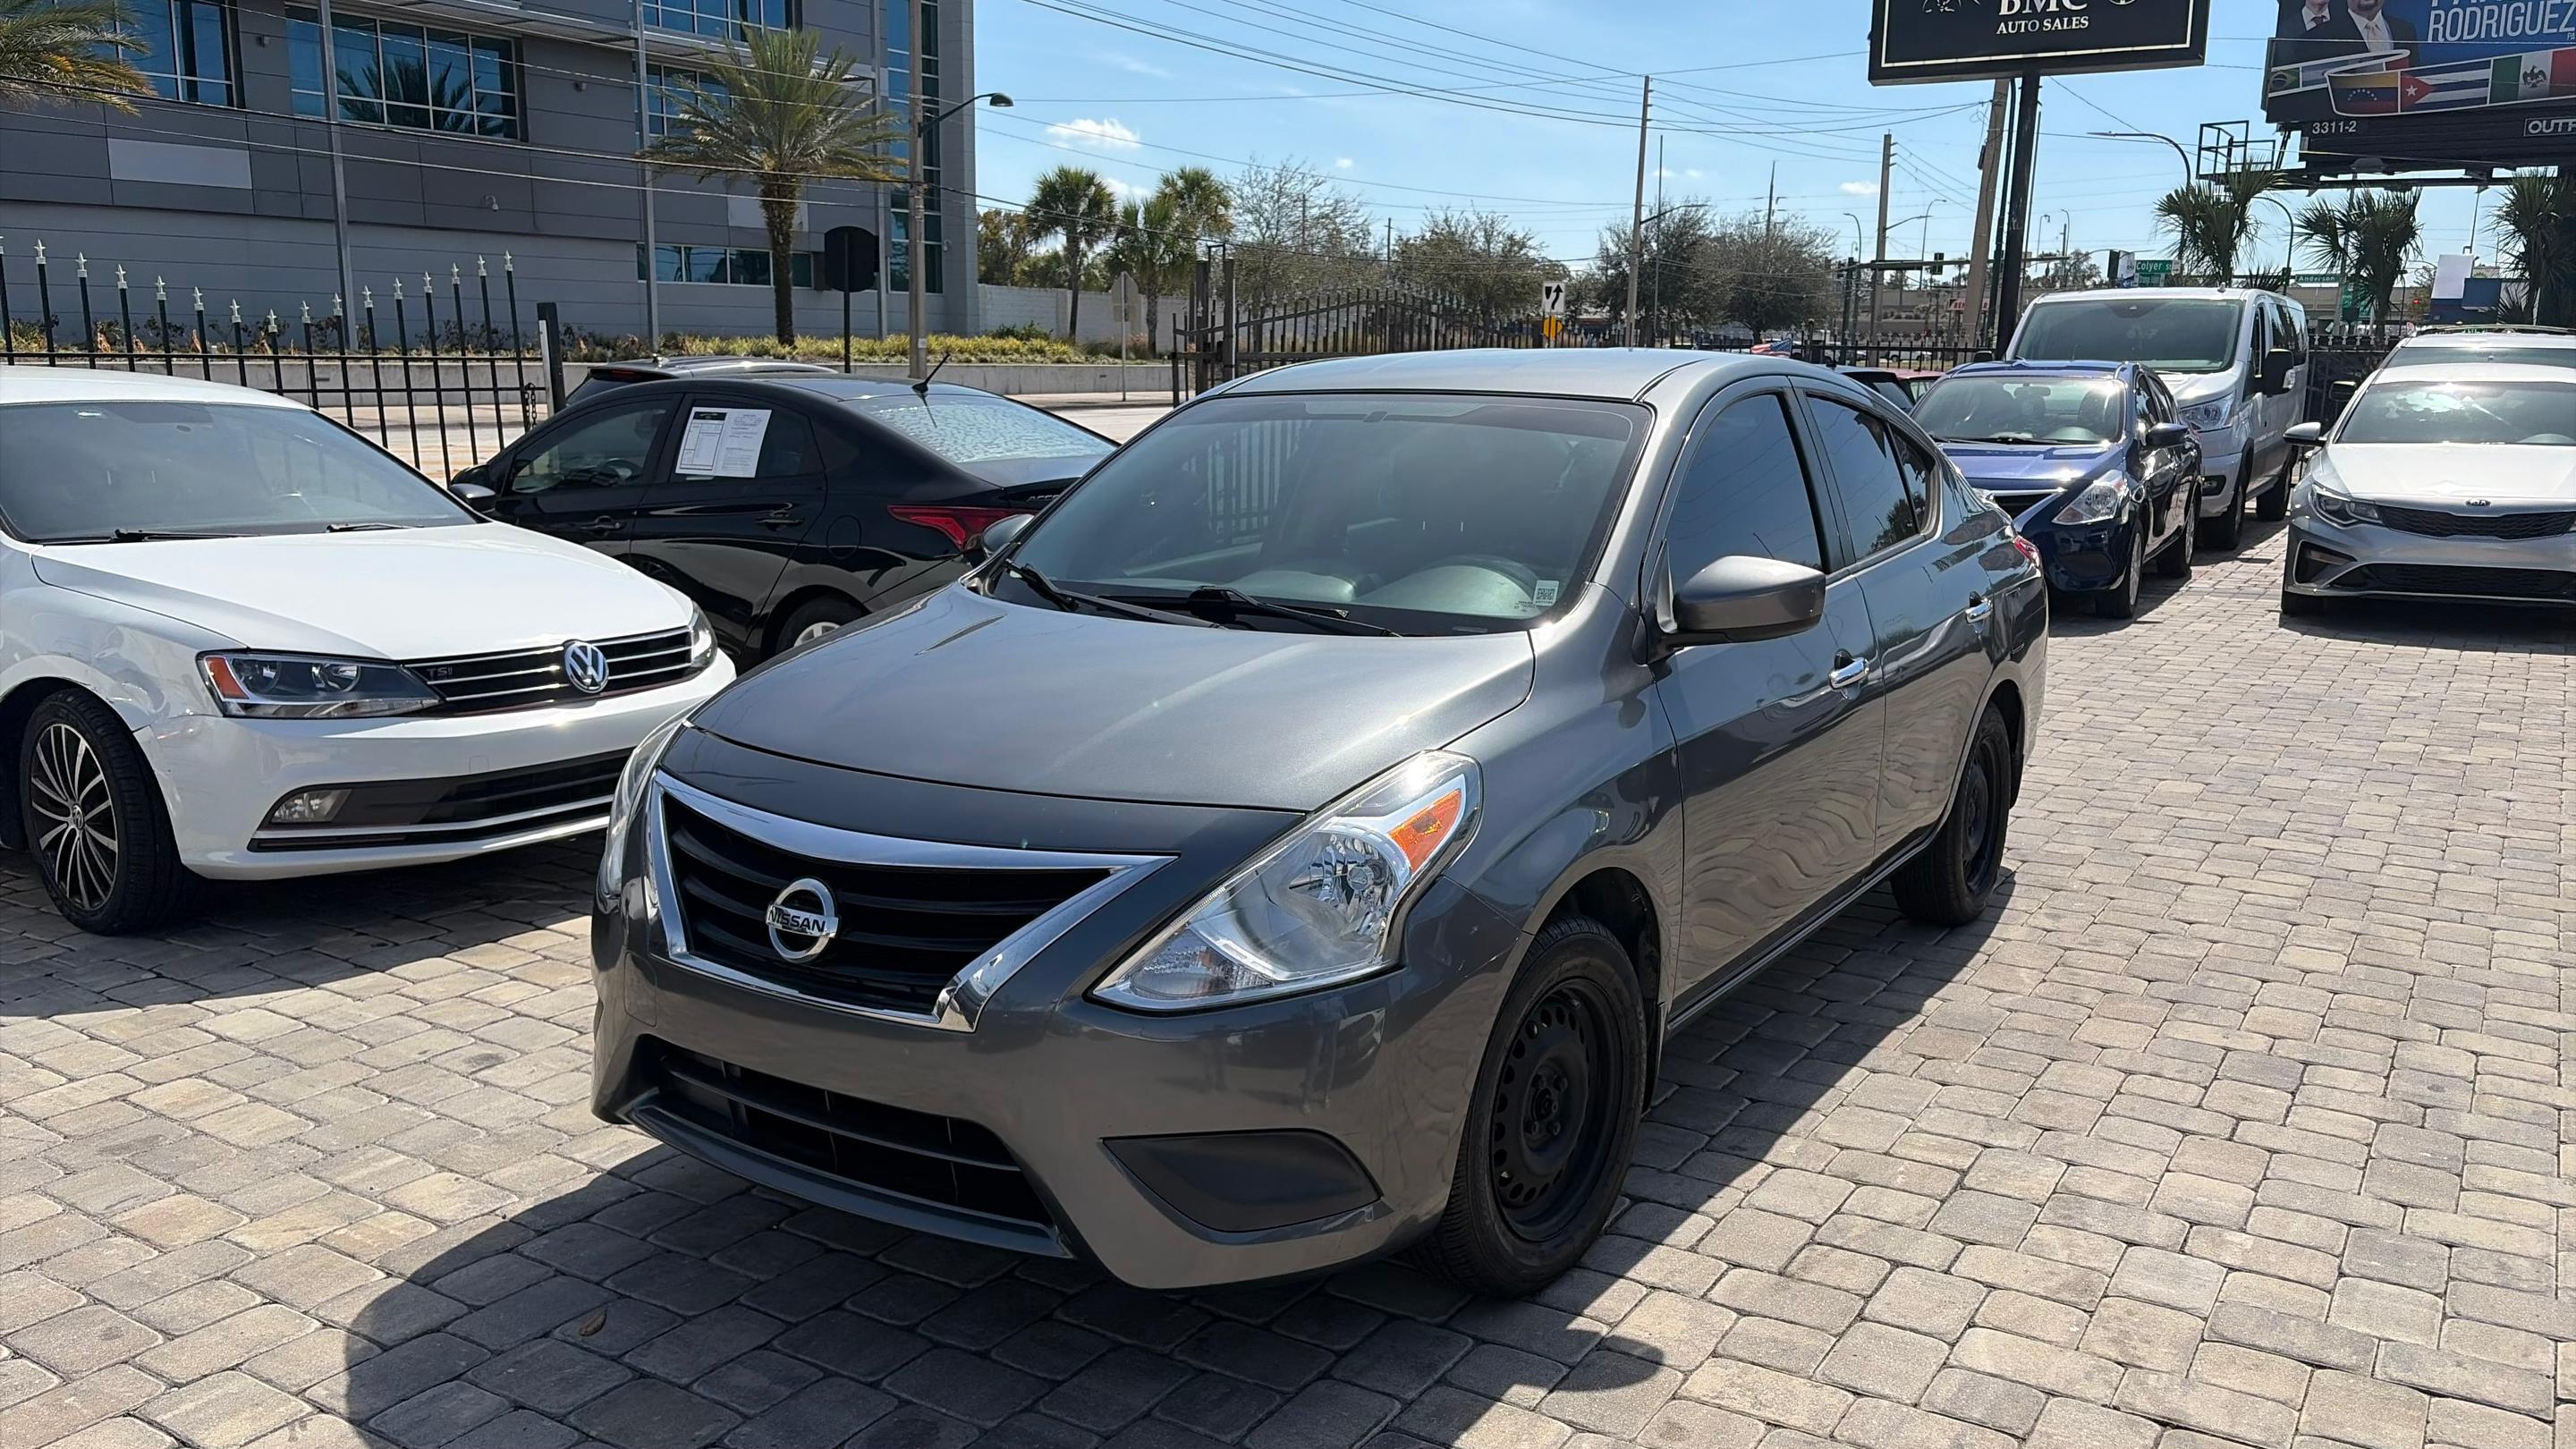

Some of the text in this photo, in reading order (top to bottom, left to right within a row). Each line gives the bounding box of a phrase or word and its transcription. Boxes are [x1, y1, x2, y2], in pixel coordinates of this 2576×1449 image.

[1996, 16, 2089, 35] AUTO SALES
[2428, 0, 2576, 42] RODRIGUEZ
[2312, 120, 2357, 134] 3311-2
[2136, 260, 2162, 272] Colyer
[427, 665, 453, 678] TSI
[768, 906, 826, 933] NISSAN
